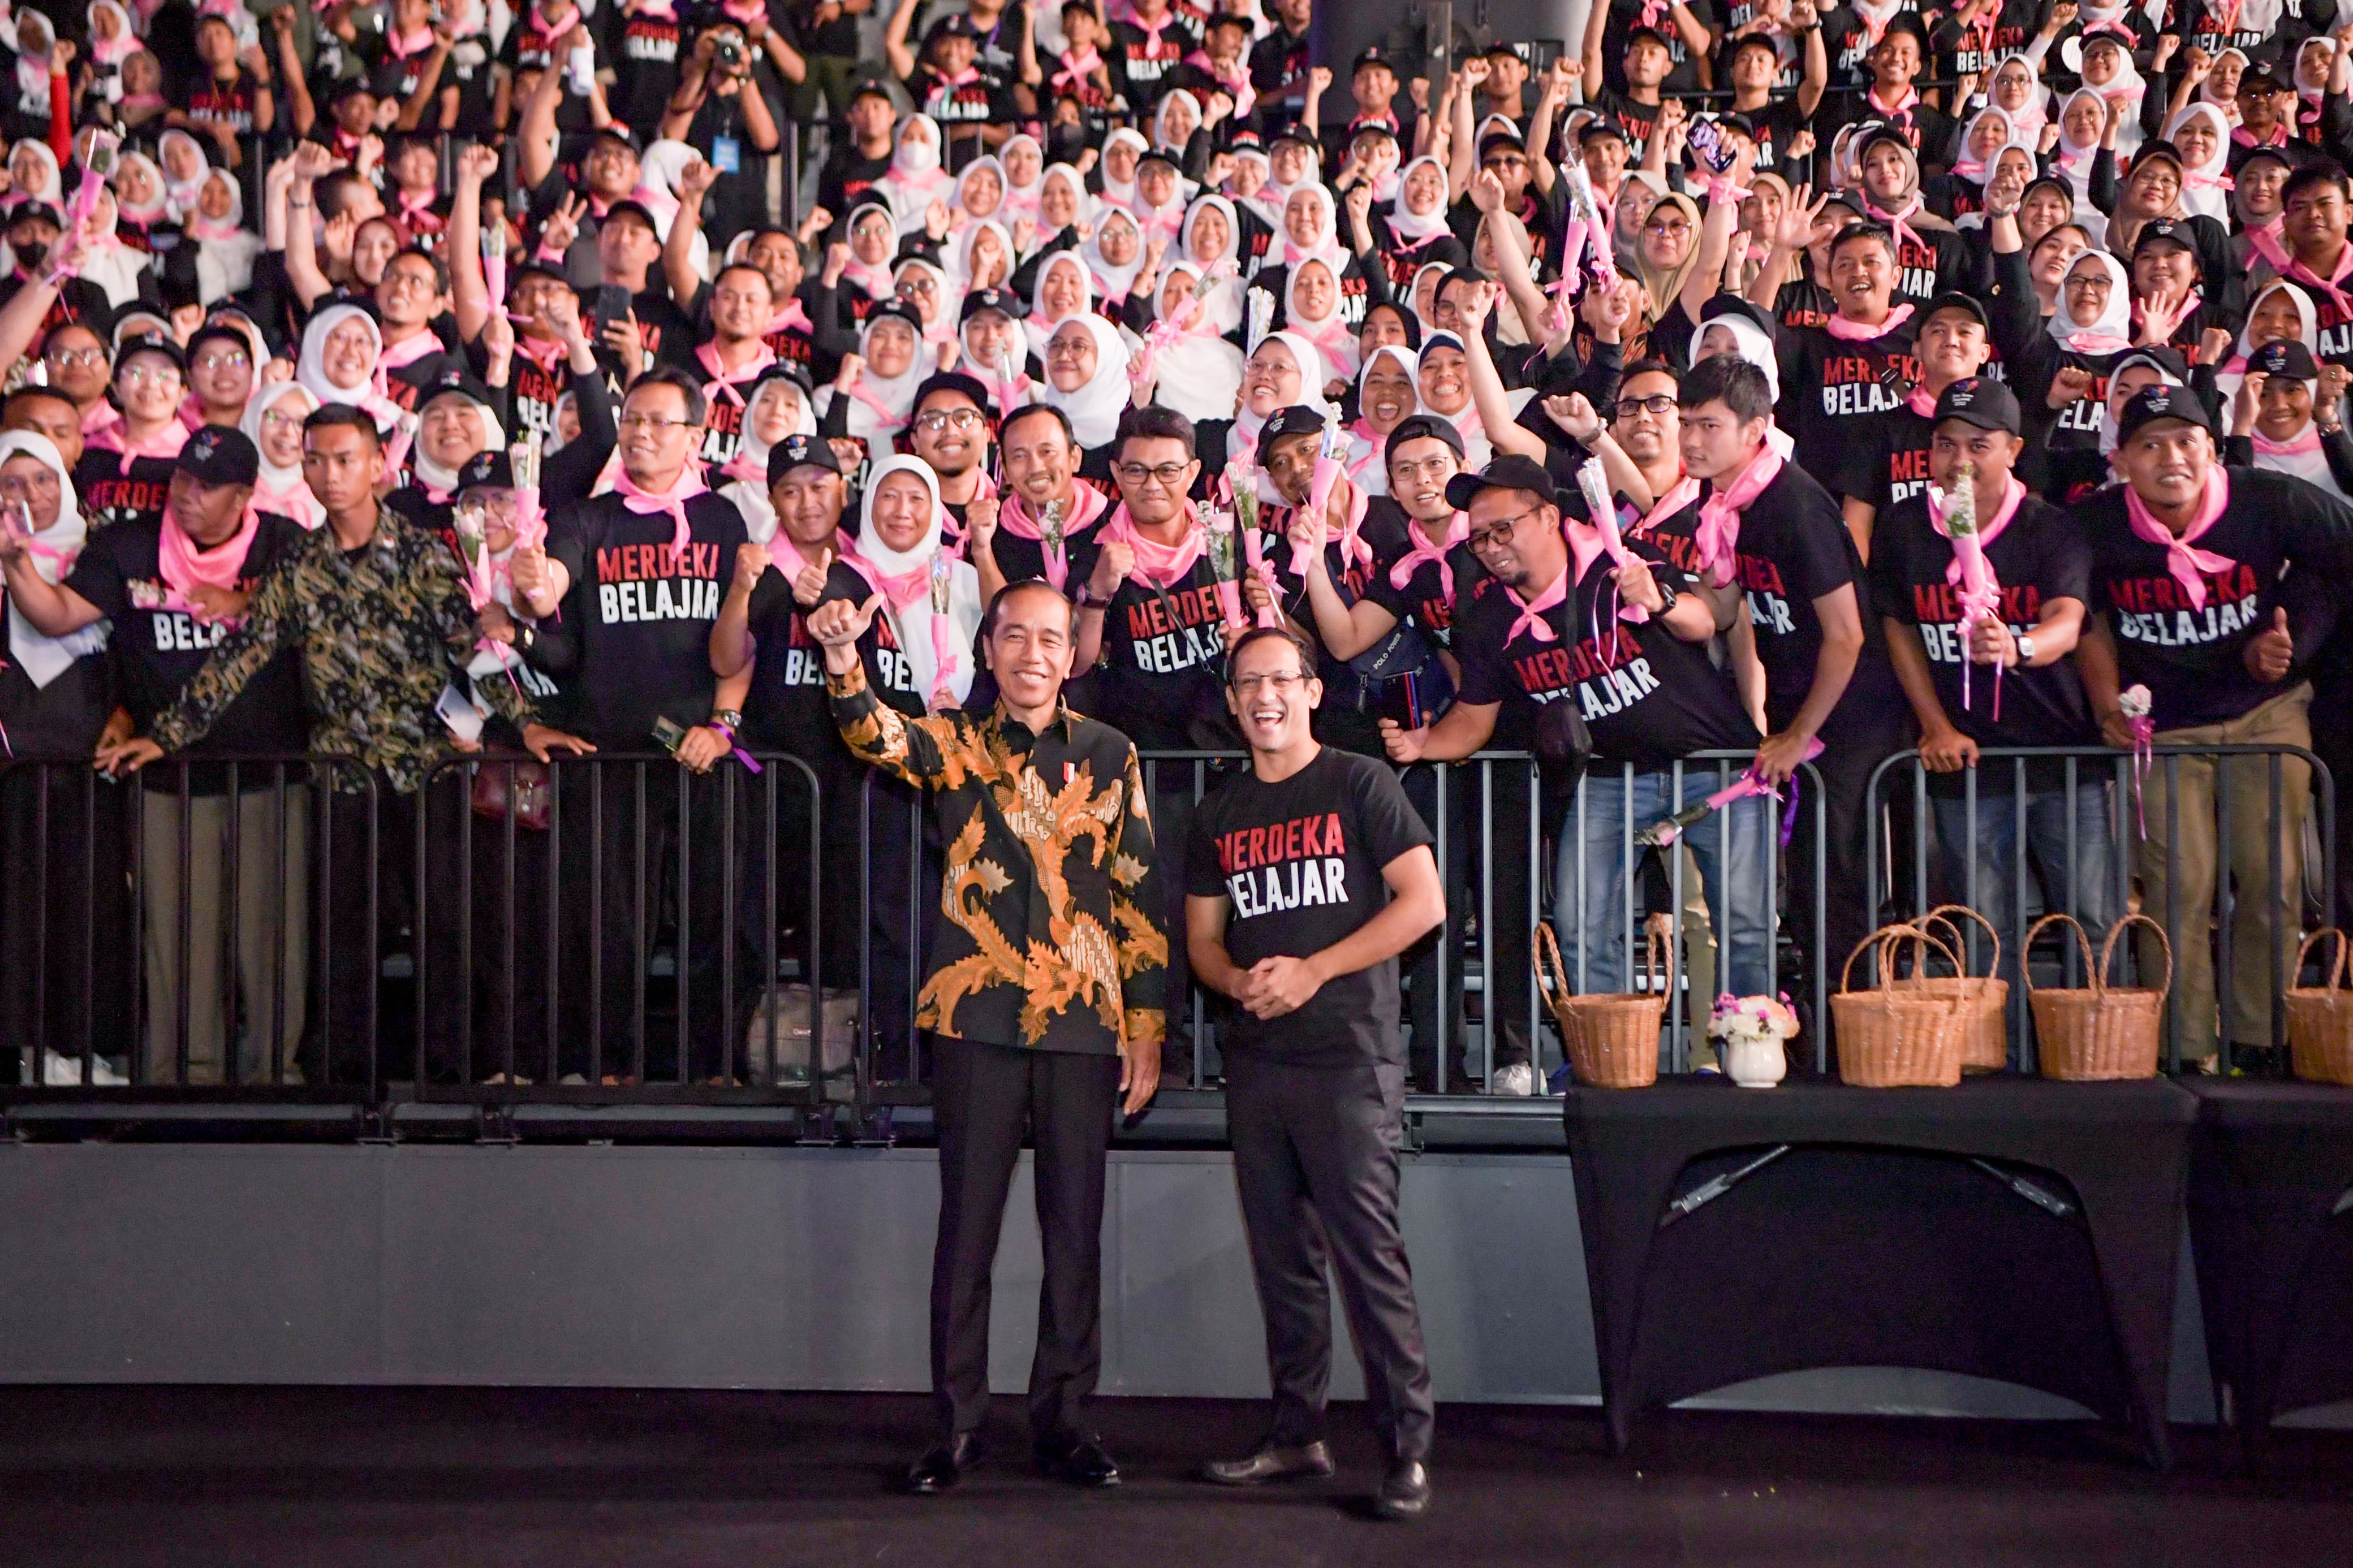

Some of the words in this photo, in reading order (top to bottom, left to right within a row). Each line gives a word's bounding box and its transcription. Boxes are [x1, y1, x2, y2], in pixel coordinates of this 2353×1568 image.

[1823, 382, 1911, 415] BELAJ
[600, 578, 719, 624] BELAJAR
[2118, 594, 2257, 645] BELAJAR
[153, 612, 227, 650] BELA
[1373, 653, 1389, 670] POLO
